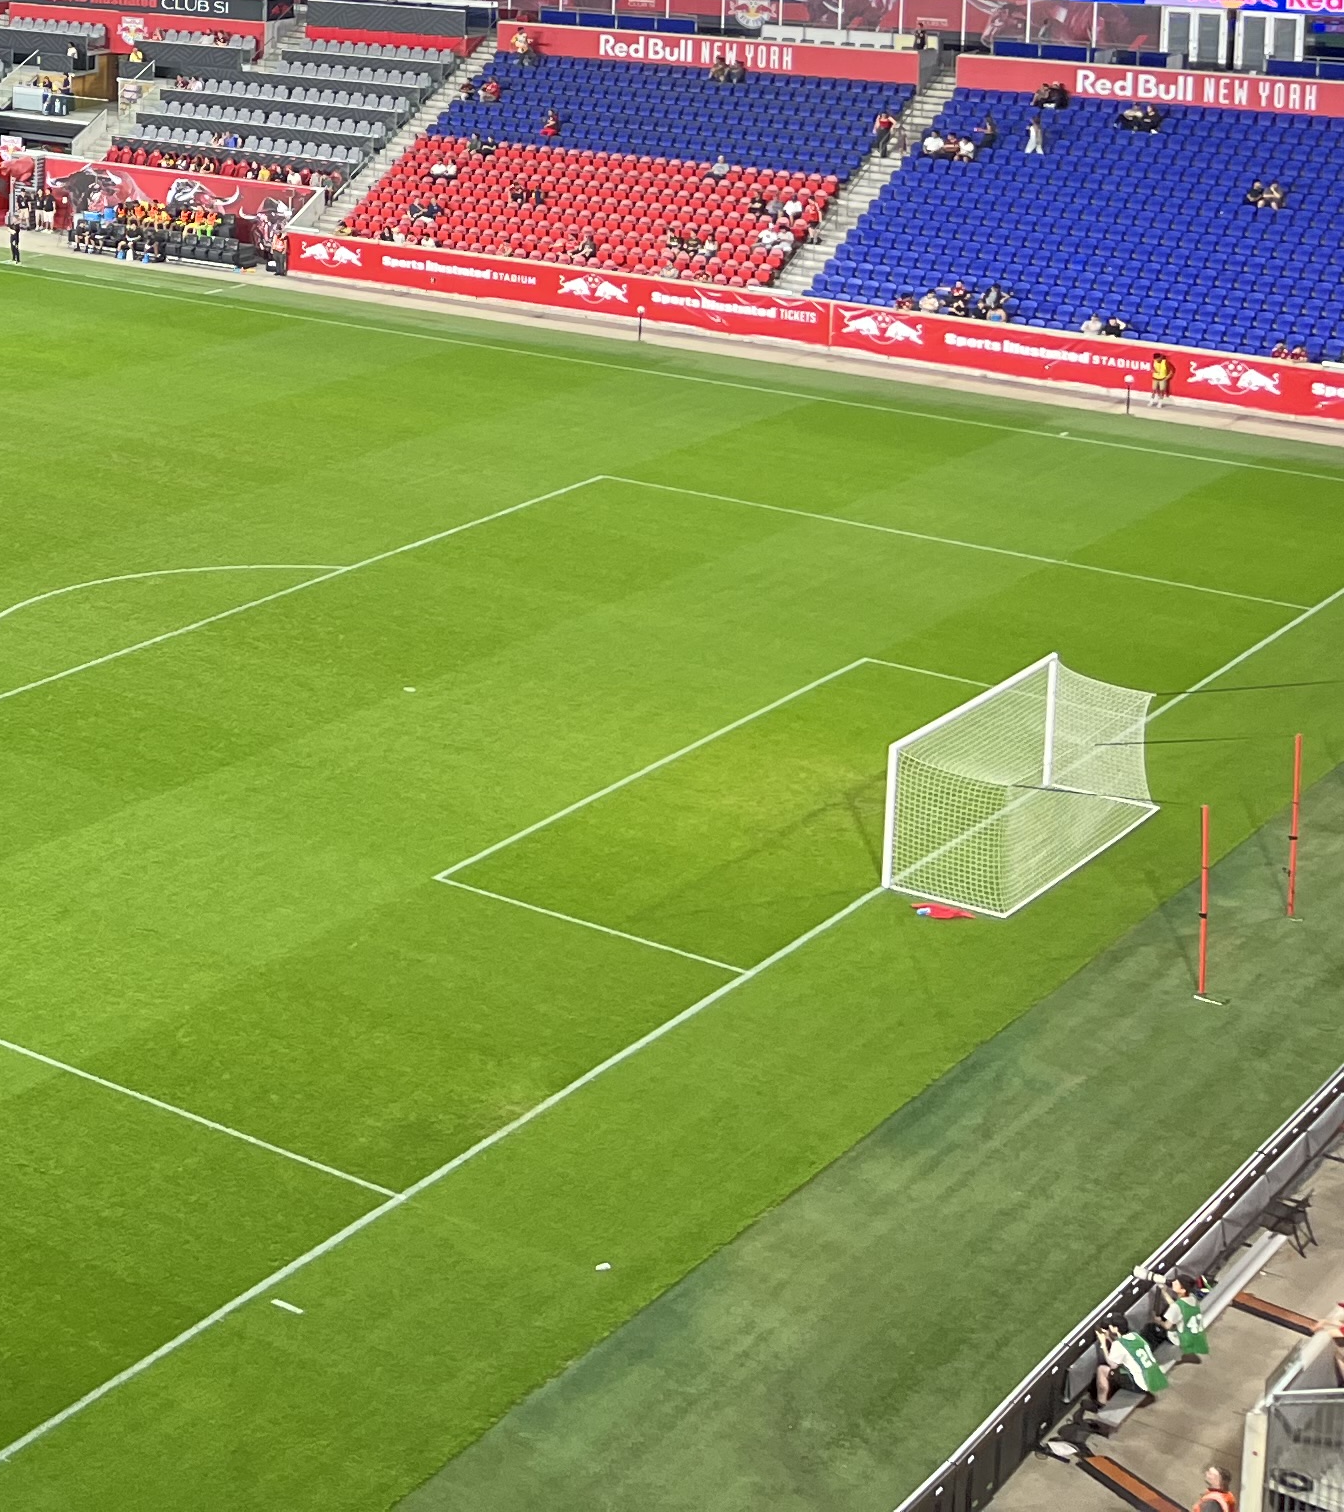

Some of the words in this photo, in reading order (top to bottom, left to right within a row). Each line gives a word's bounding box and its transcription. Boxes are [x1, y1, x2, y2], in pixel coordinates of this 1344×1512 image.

[214, 1, 229, 14] SI
[600, 34, 646, 59] Red
[647, 37, 693, 63] Bull
[701, 41, 738, 66] NEW
[745, 44, 792, 70] YORK
[1076, 68, 1133, 97] Red
[1137, 73, 1193, 102] Bull
[1203, 77, 1248, 105] NEW
[1258, 81, 1317, 111] YORK
[381, 255, 424, 271] Sports
[425, 259, 491, 280] Illustrated
[492, 271, 536, 285] STADIUM
[651, 290, 700, 309] Sports
[701, 295, 777, 319] Illustrated
[779, 308, 817, 324] TICKETS
[944, 332, 1001, 353] Sports
[1002, 338, 1091, 365] Illustrated
[1091, 356, 1151, 372] STADIUM
